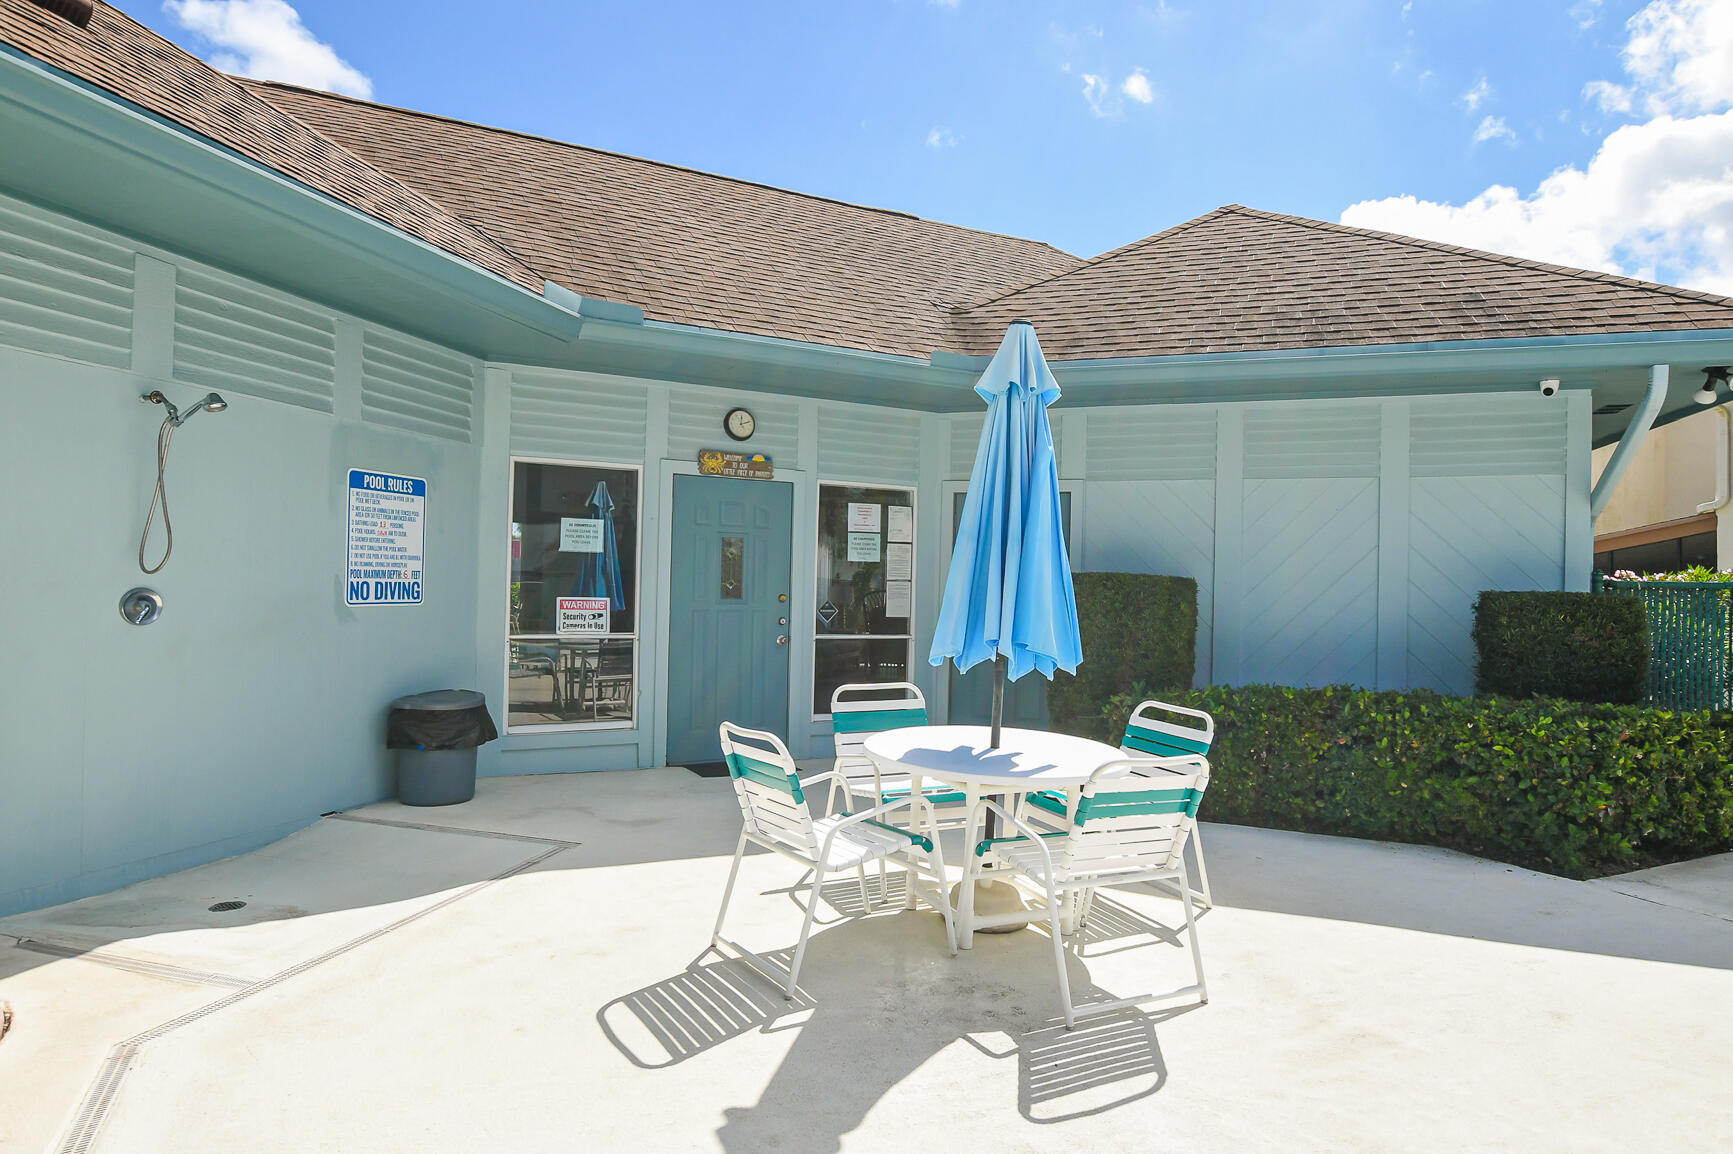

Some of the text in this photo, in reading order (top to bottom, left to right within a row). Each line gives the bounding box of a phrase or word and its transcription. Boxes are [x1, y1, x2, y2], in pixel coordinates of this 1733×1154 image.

[364, 474, 413, 494] POOL RULES
[350, 568, 362, 578] POOL
[364, 569, 386, 579] MAXIMUM
[403, 570, 408, 579] 6
[411, 570, 421, 580] FEET
[350, 581, 420, 600] NO DIVING
[562, 601, 605, 609] WARNING
[563, 612, 586, 621] Security
